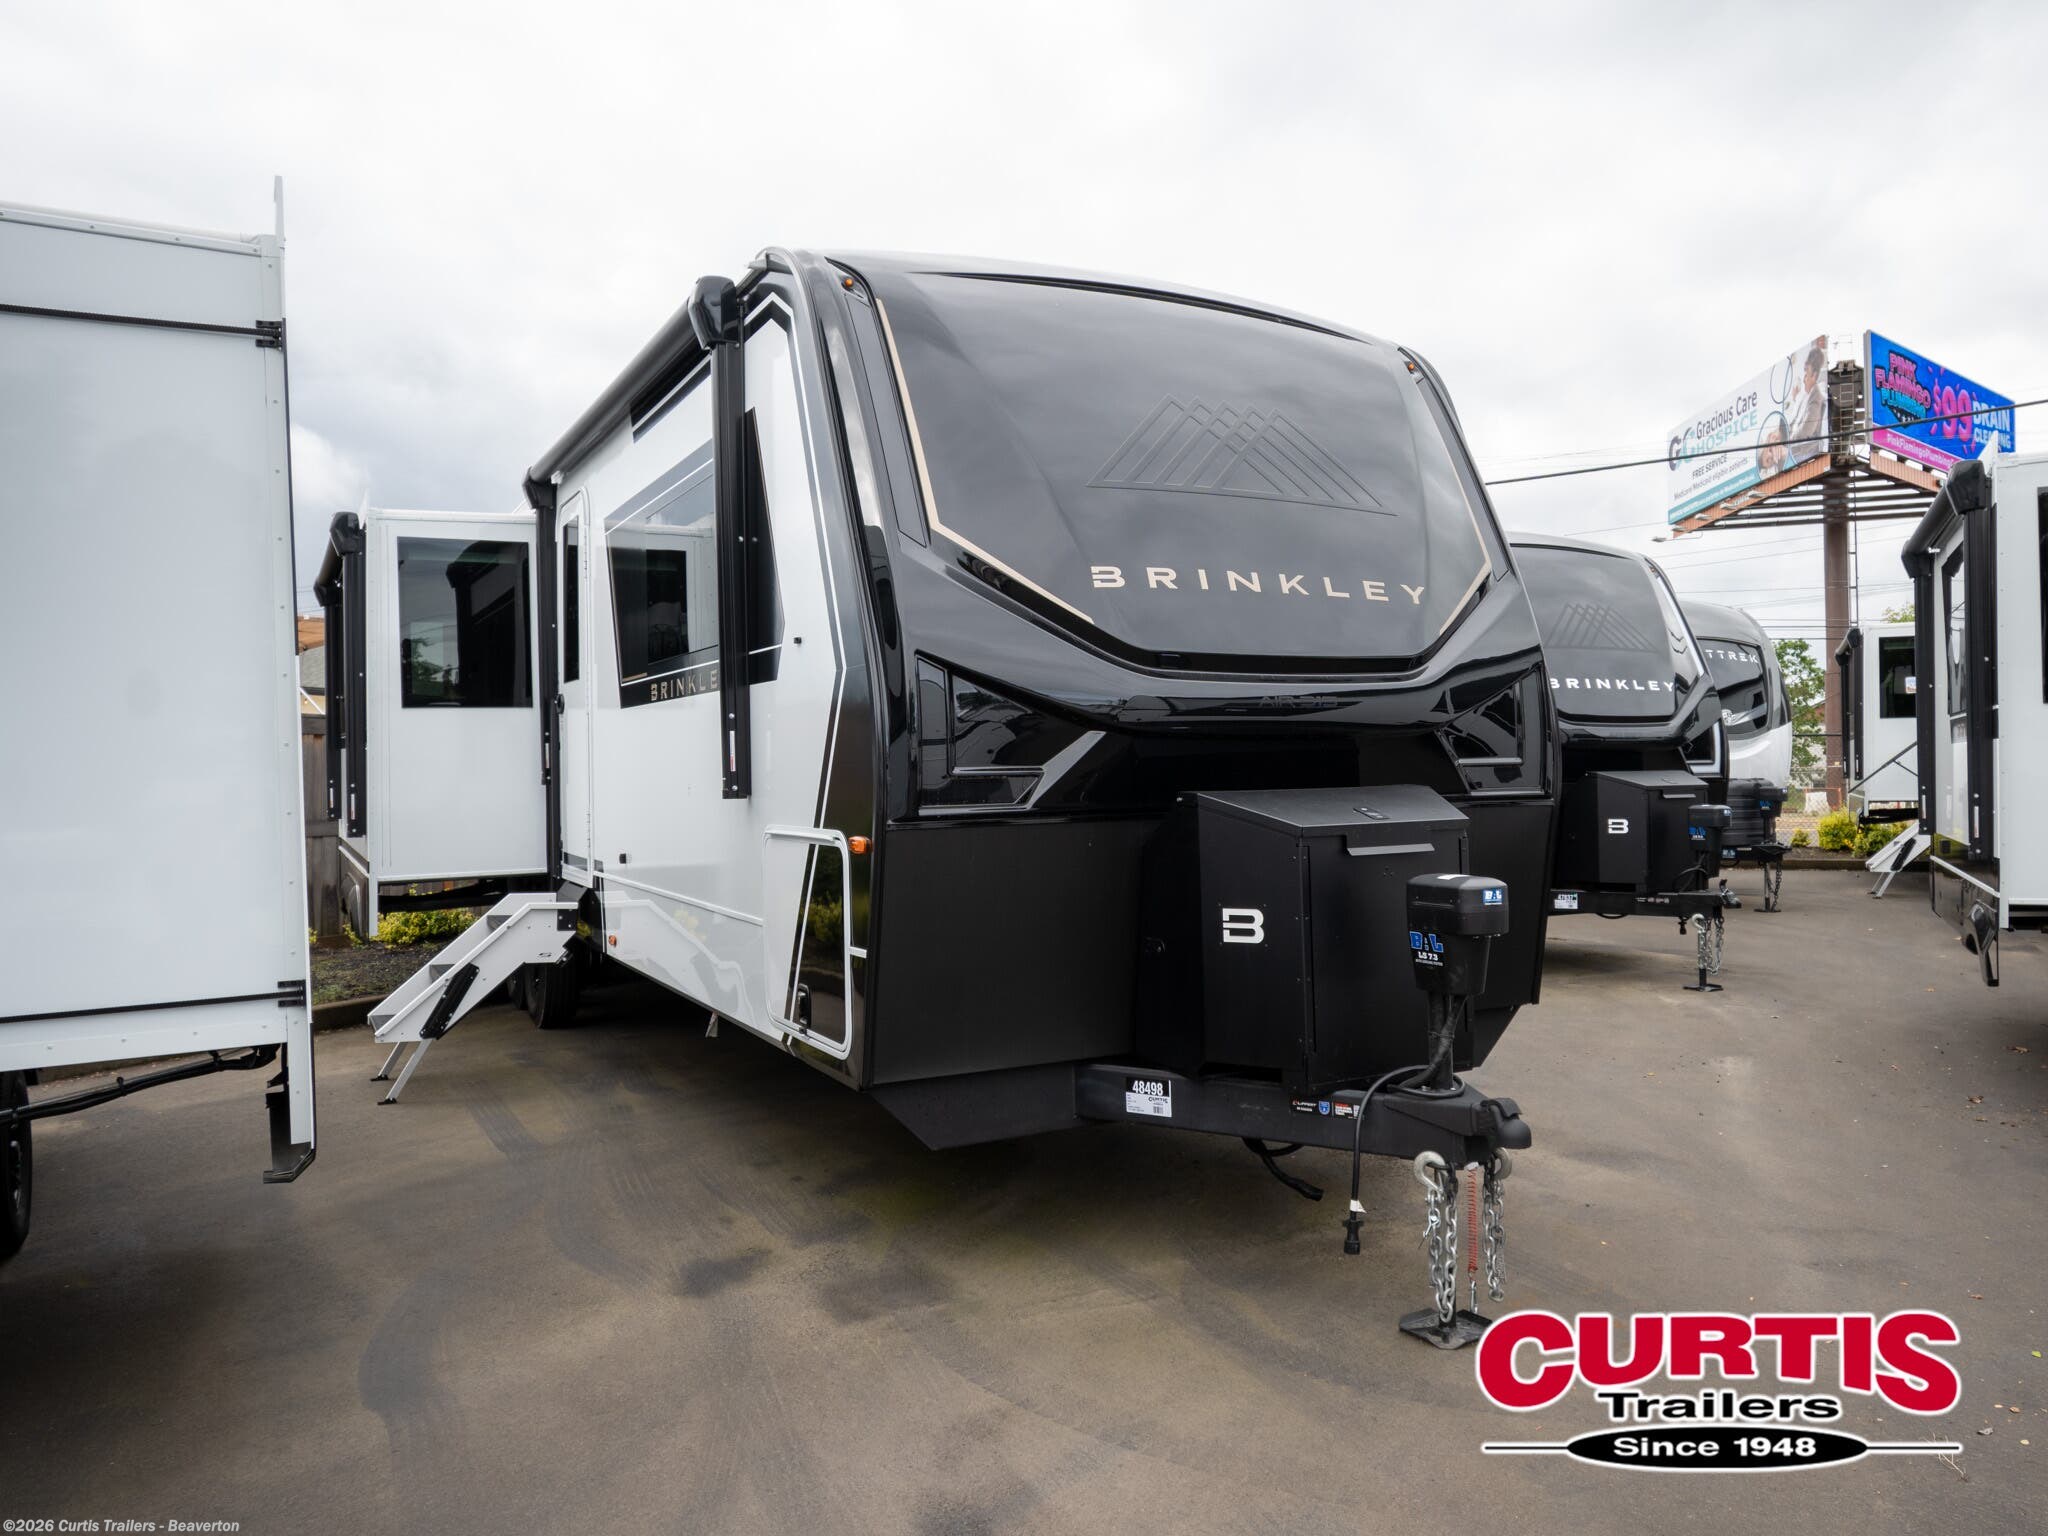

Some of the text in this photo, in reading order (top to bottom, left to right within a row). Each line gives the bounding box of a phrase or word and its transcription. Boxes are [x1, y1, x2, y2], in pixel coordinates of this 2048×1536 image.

[1696, 391, 1758, 440] Gracious Care
[1696, 408, 1759, 456] HOSPICE
[1972, 400, 2010, 432] DRAIN
[1091, 565, 1424, 605] BRINKLEY
[1705, 649, 1759, 664] TTREK
[650, 668, 719, 702] BRINKLE
[1549, 677, 1674, 693] BRINKLEY
[1222, 908, 1265, 944] B
[1132, 1080, 1164, 1096] 48498
